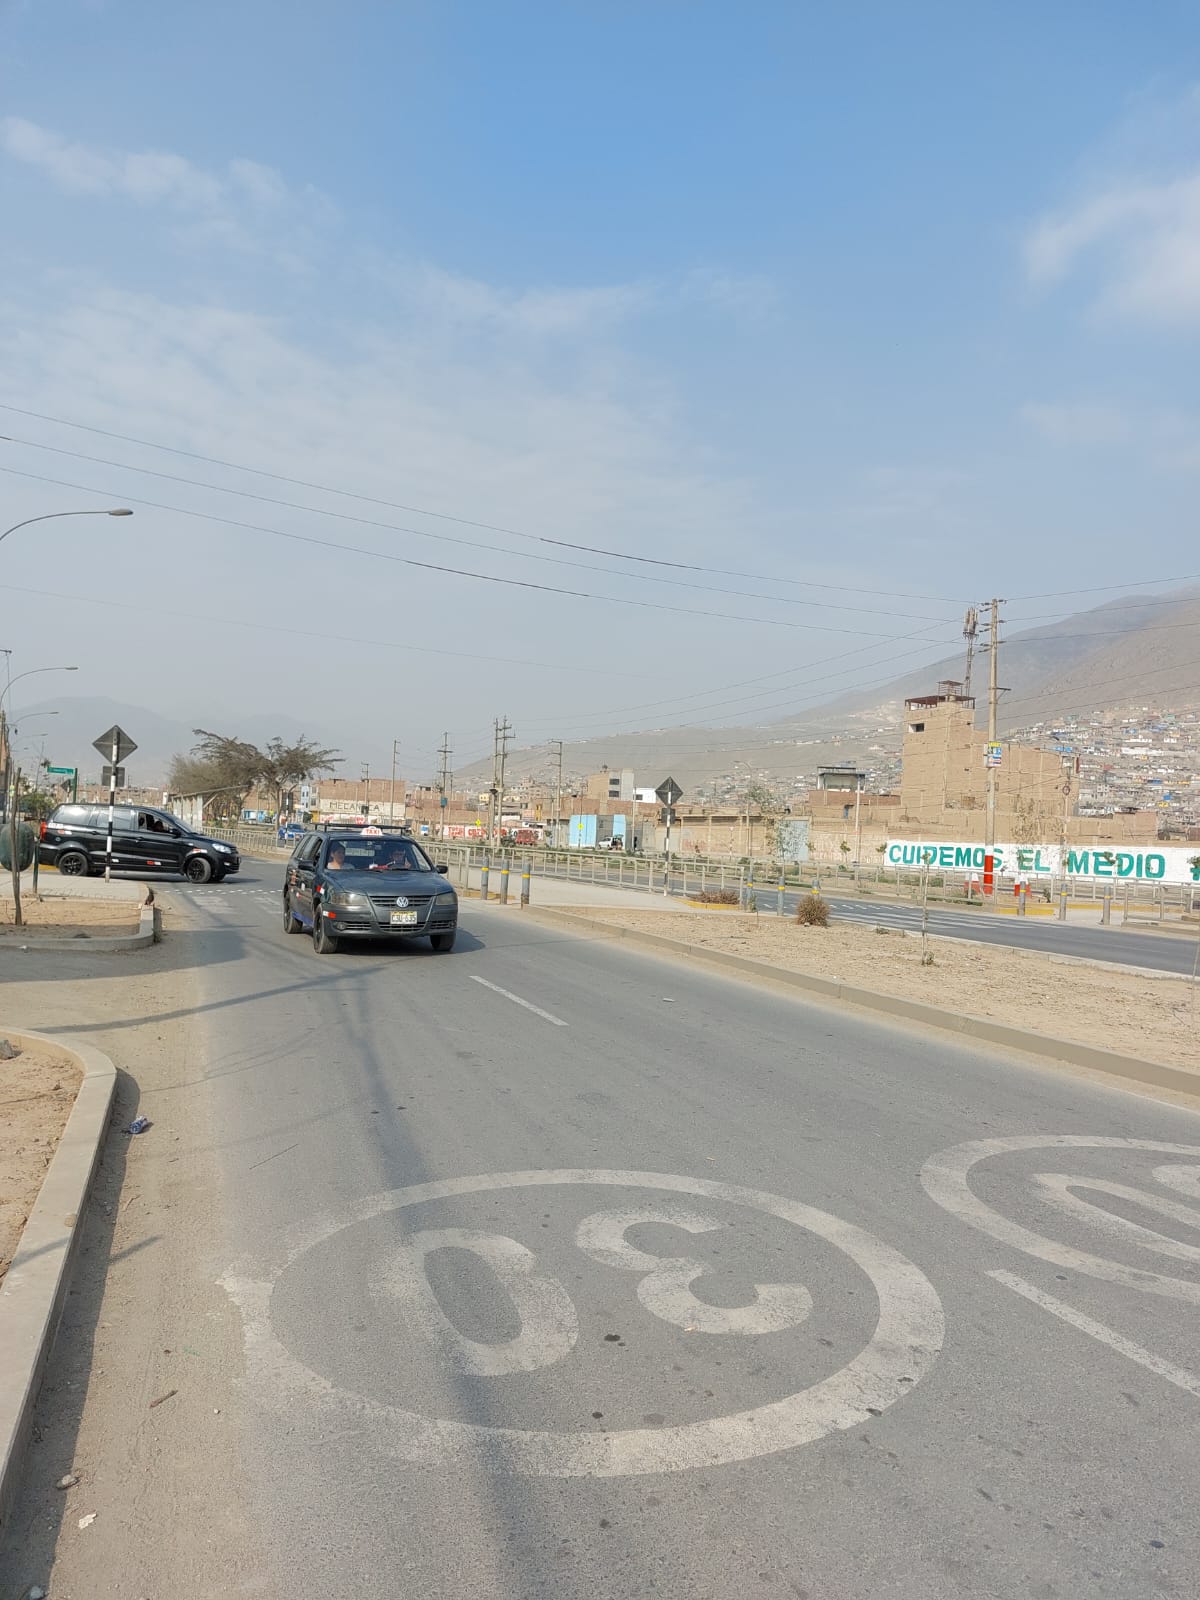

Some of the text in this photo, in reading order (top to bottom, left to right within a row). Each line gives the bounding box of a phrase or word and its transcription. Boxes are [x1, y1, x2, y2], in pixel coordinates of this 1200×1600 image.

[888, 844, 1004, 869] CUIDEMOS
[1017, 848, 1051, 872] EL
[1067, 850, 1166, 879] MEDIO
[368, 1208, 814, 1377] 30
